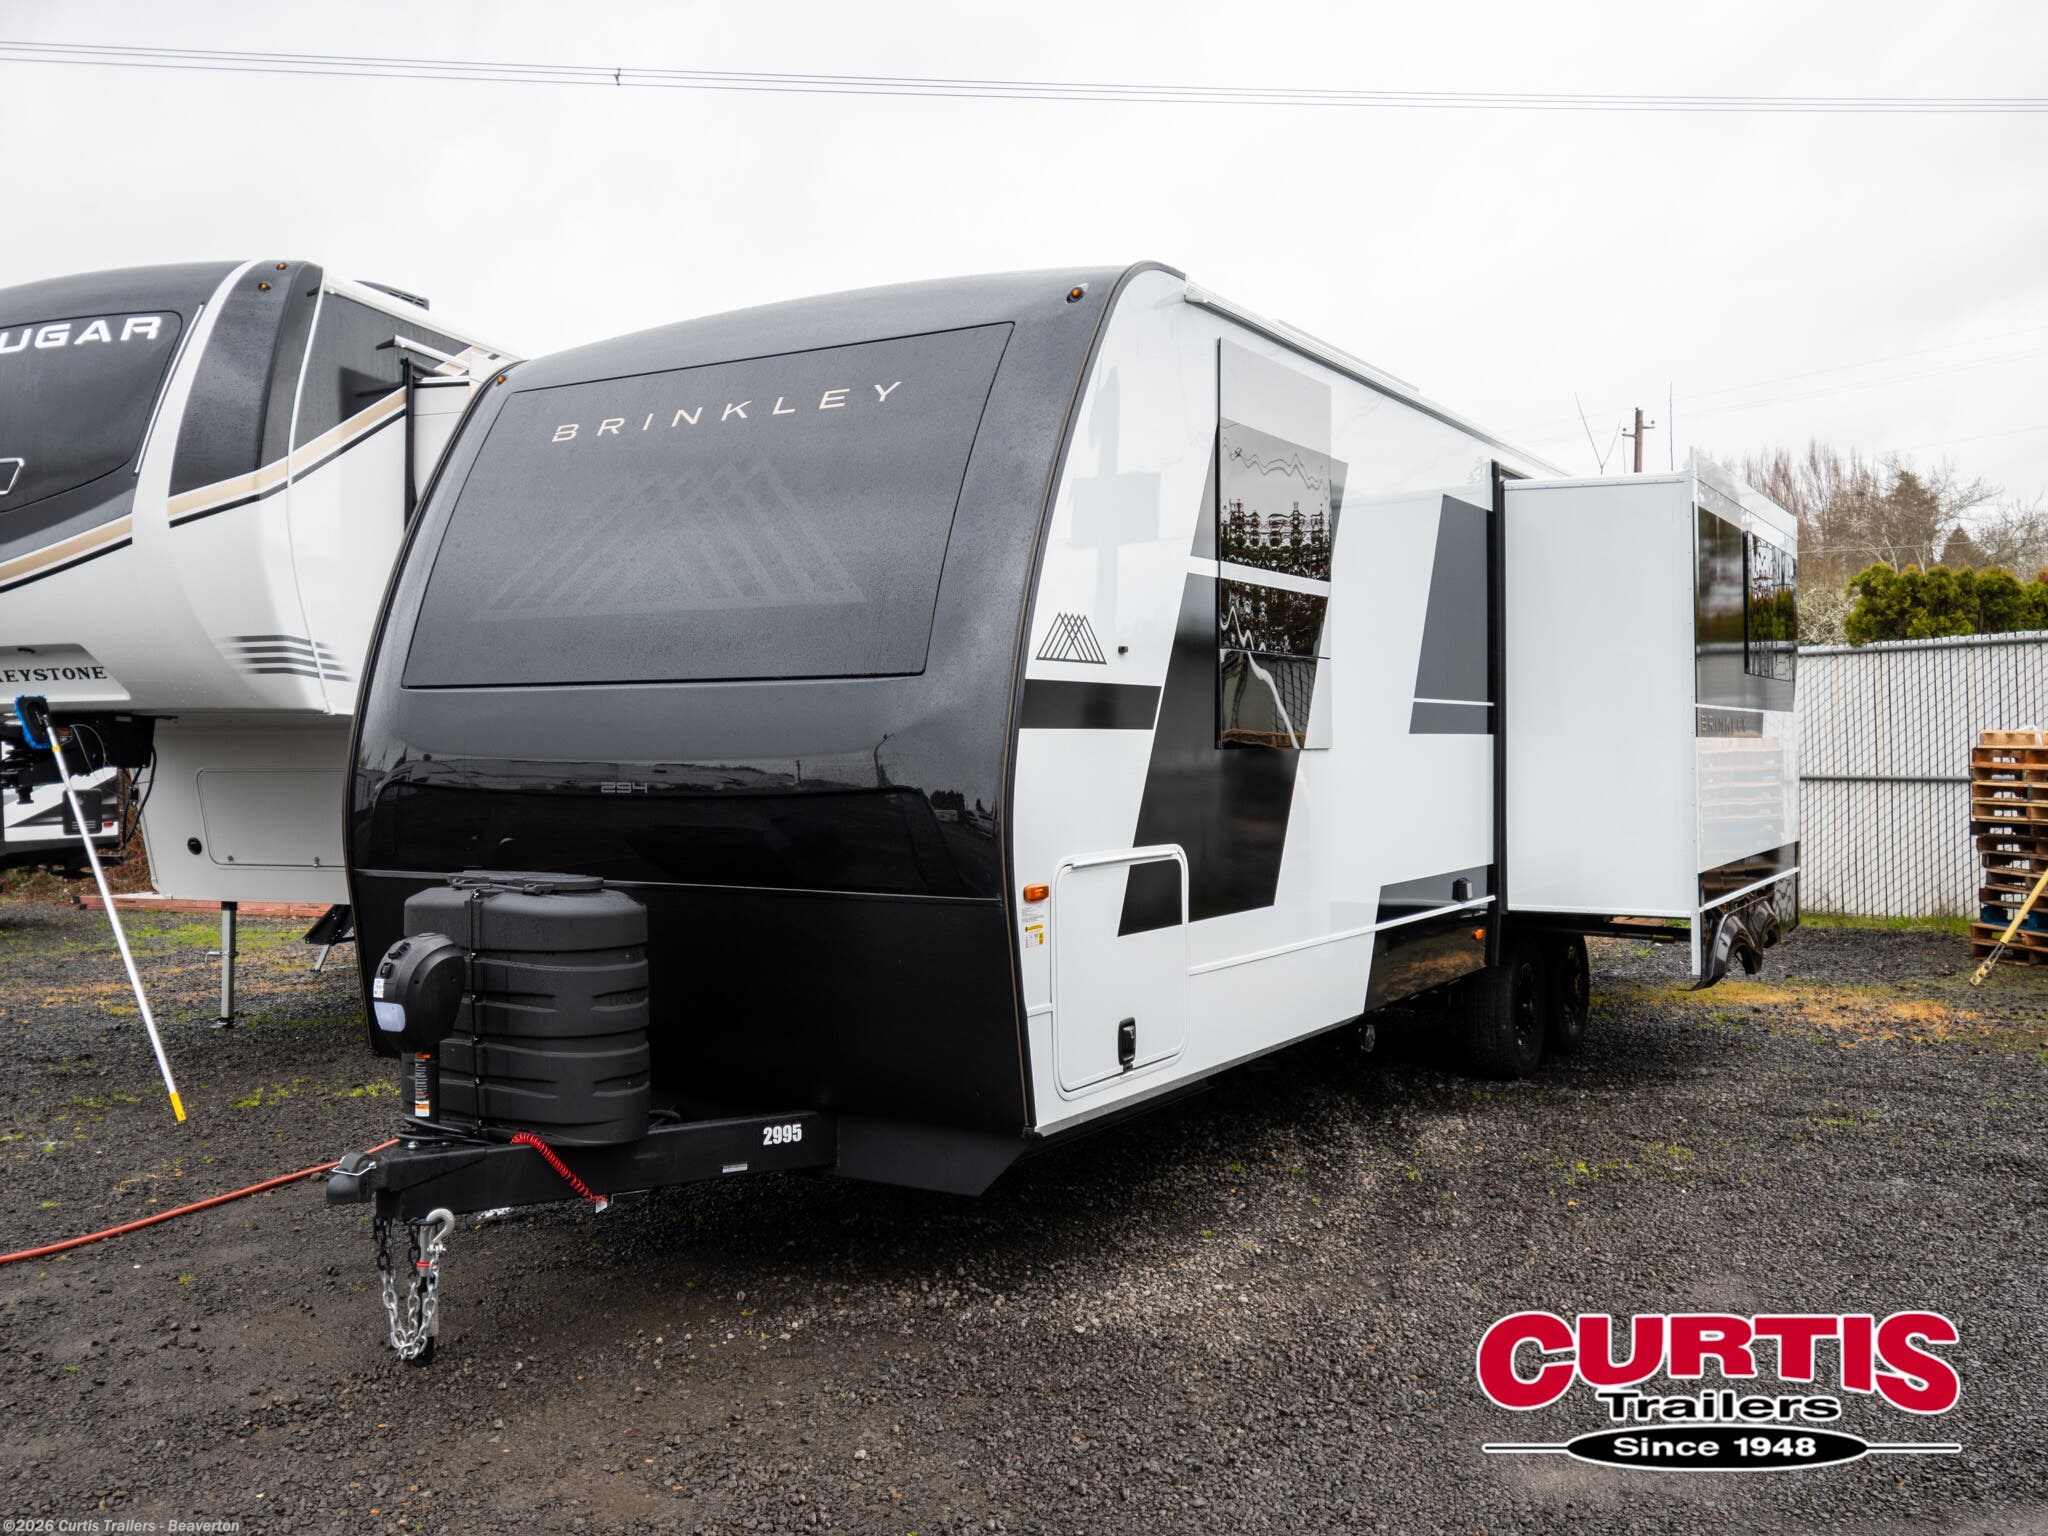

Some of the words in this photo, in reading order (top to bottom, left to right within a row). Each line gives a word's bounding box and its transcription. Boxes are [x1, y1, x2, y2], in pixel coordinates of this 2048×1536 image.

[551, 381, 902, 442] BRINKLEY
[0, 666, 107, 683] EYSTONE
[600, 781, 648, 794] 294
[763, 1123, 802, 1146] 2995
